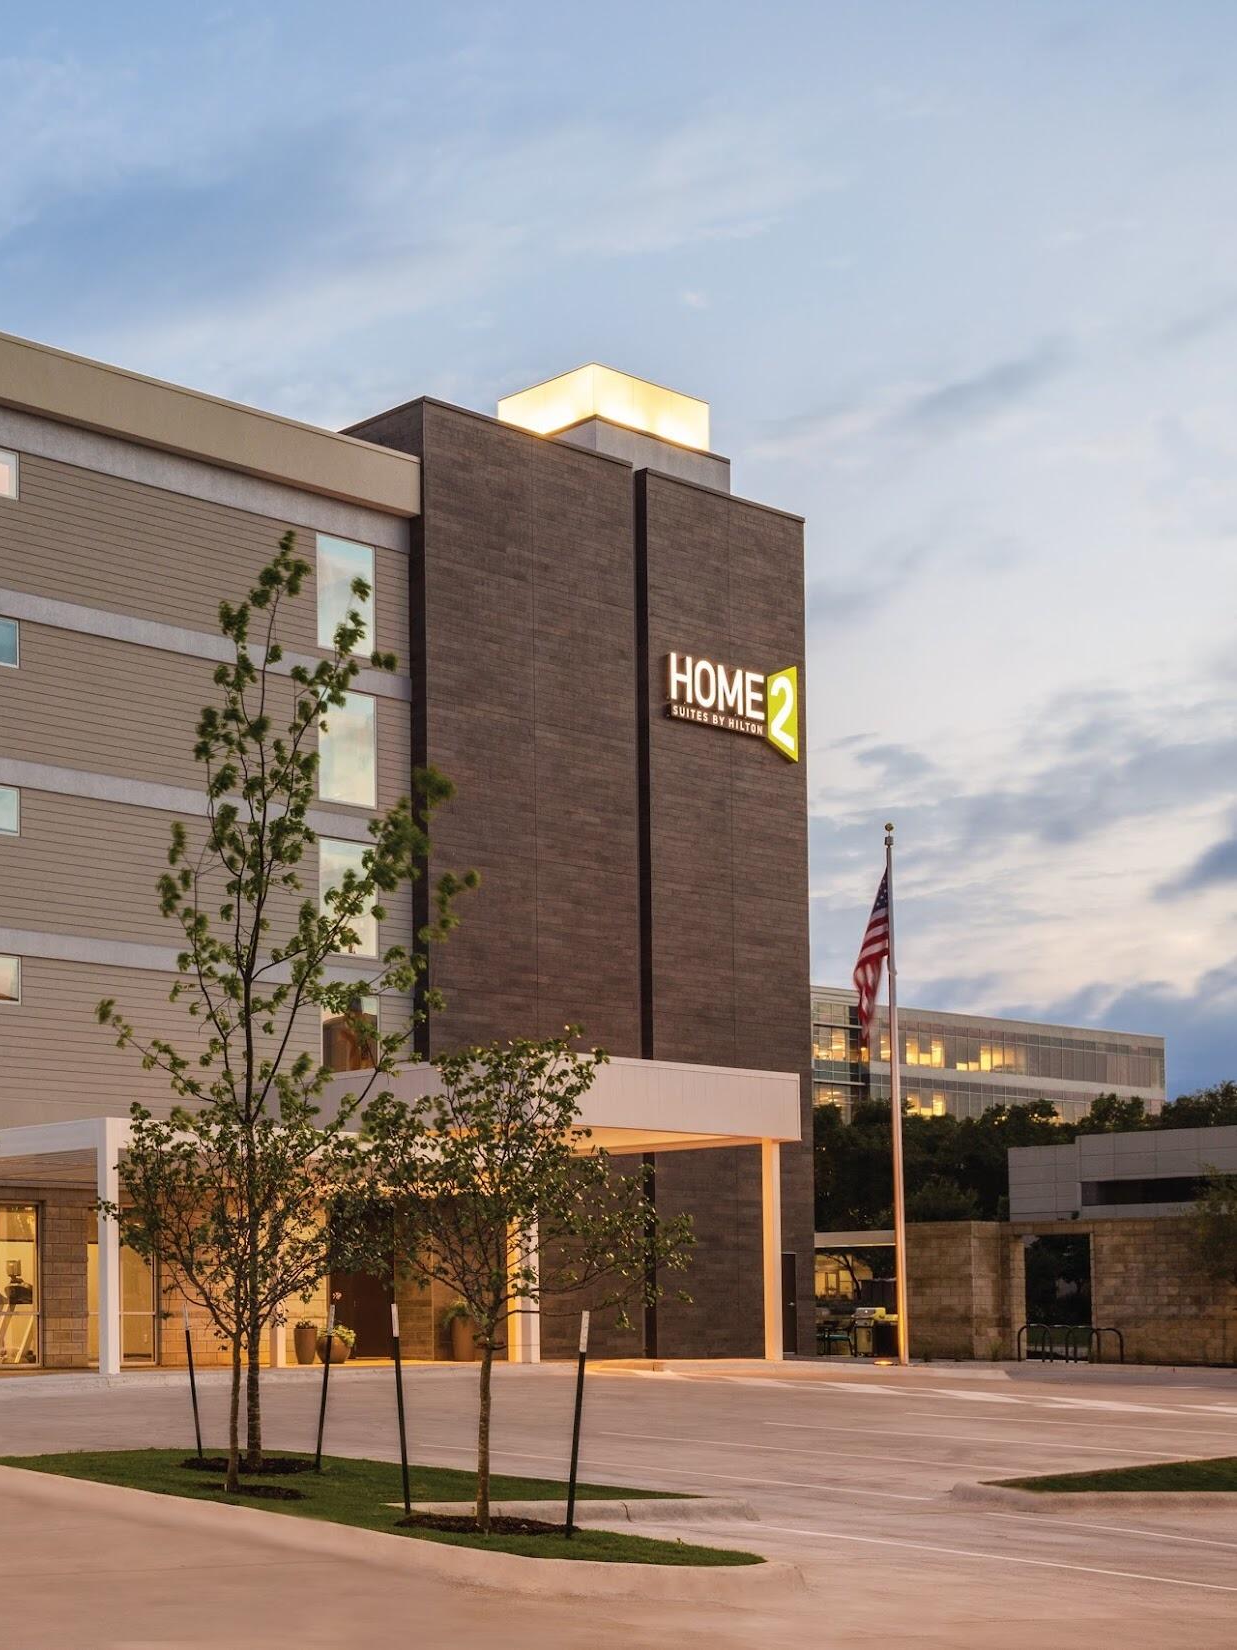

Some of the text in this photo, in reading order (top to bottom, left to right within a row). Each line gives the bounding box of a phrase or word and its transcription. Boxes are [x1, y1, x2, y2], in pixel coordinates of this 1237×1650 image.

[670, 652, 795, 752] HOME 2
[672, 705, 763, 735] SUITES BY HILTON
